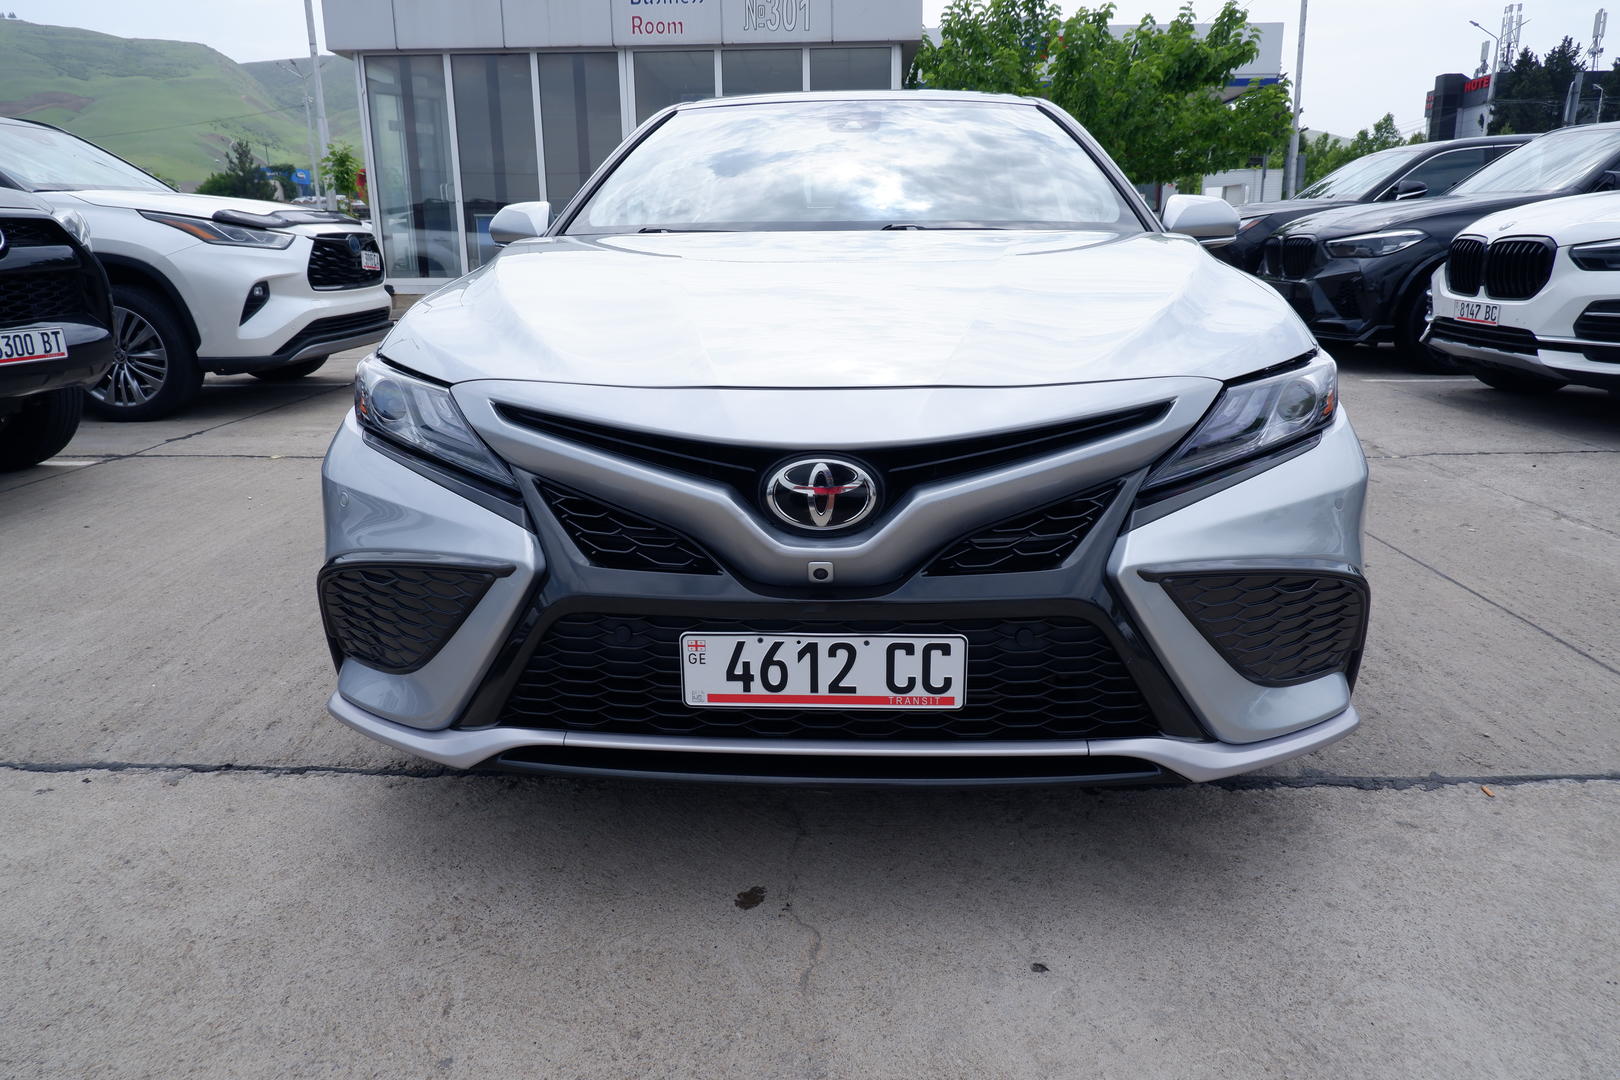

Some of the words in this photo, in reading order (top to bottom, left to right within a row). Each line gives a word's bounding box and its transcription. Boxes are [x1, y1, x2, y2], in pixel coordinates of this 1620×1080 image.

[631, 15, 683, 35] Room
[1464, 74, 1492, 93] HOTE
[1460, 302, 1481, 319] 8147
[1484, 305, 1498, 321] BC
[38, 331, 60, 353] BT
[688, 653, 706, 665] GE
[726, 641, 857, 694] 4612
[886, 642, 952, 695] CC
[888, 696, 940, 705] TRANSIT
